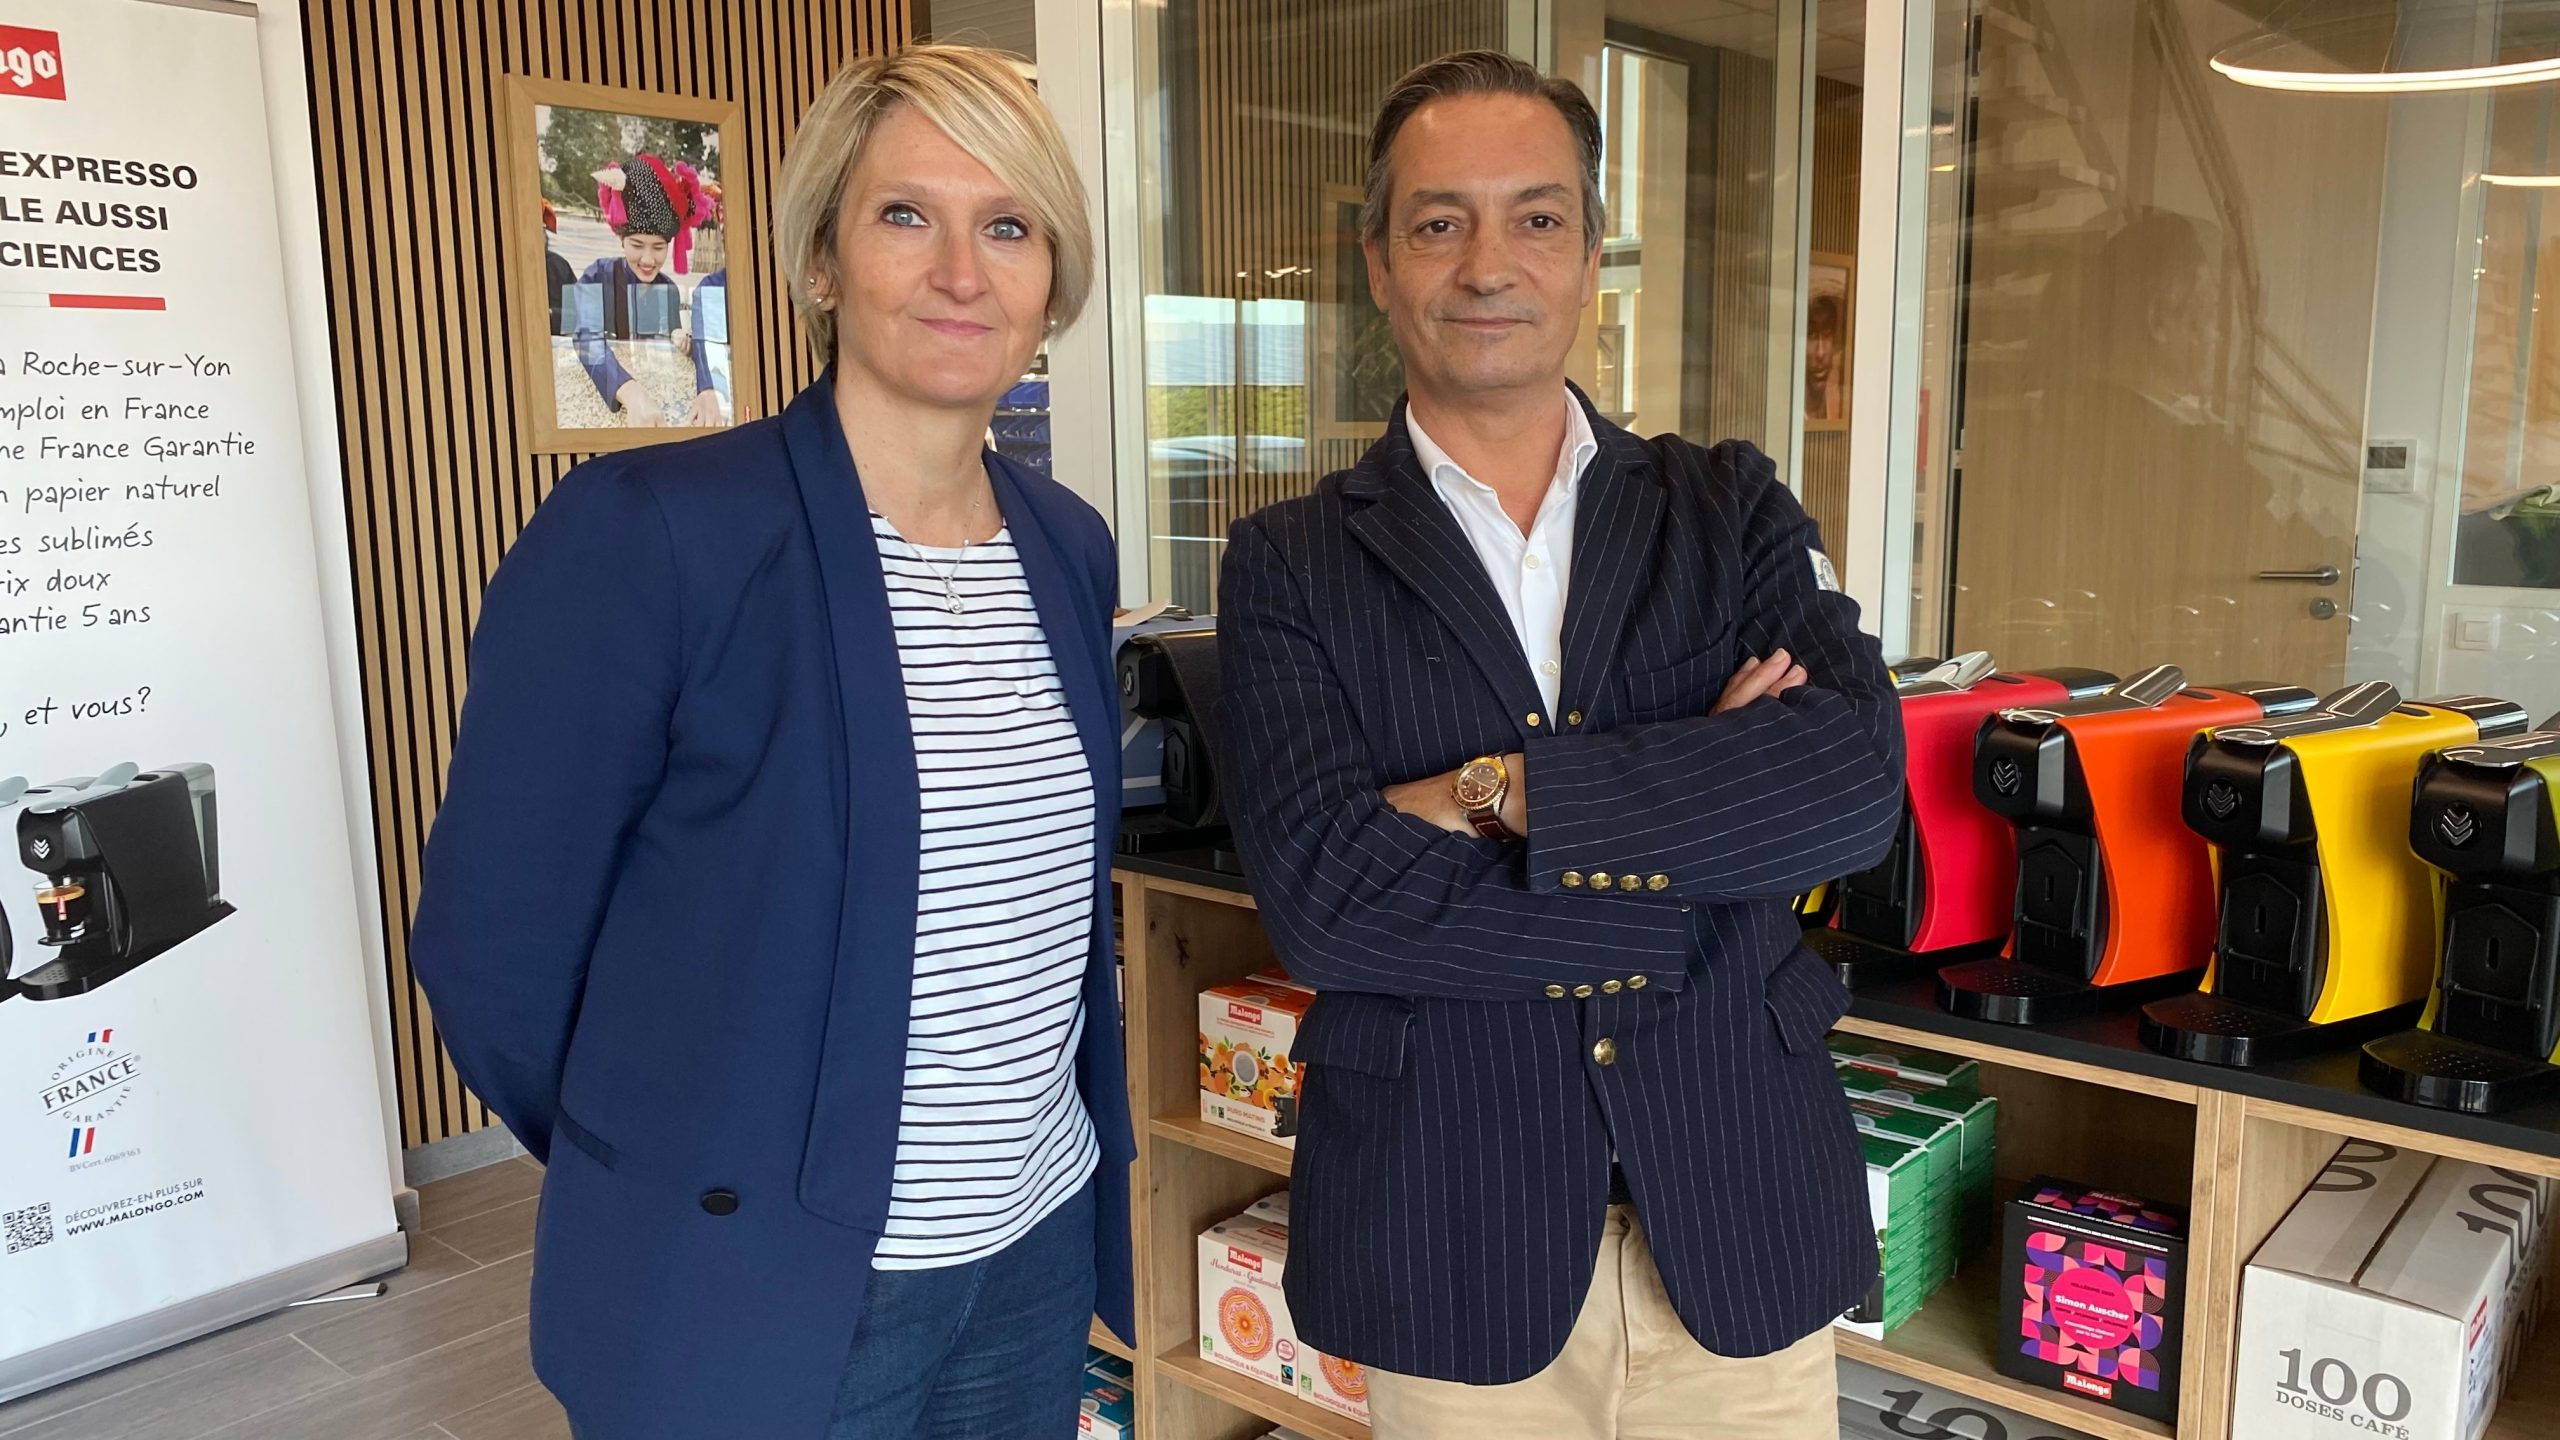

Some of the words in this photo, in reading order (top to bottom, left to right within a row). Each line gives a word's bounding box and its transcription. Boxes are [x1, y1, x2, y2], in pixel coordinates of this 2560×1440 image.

[0, 151, 198, 190] EXPRESSO
[55, 200, 169, 231] AUSSI
[0, 241, 161, 273] CIENCES
[23, 351, 231, 377] Roche-sur-Yon
[81, 404, 109, 420] en
[124, 397, 209, 420] France
[40, 436, 129, 459] France
[144, 432, 255, 462] Garantie
[26, 477, 110, 513] papier
[126, 475, 220, 500] naturel
[38, 521, 153, 552] sublimés
[47, 568, 111, 592] doux
[82, 603, 101, 627] 5
[109, 606, 151, 625] ans
[25, 696, 59, 725] et
[72, 686, 151, 719] vous?
[1229, 1004, 1261, 1023] Malongo
[51, 1047, 115, 1081] ORIGINE
[42, 1057, 137, 1109] FRANCE
[62, 1086, 132, 1123] GARANTIE
[65, 1191, 153, 1225] DÉCOUVREZ-EN
[156, 1183, 181, 1199] PLUS
[183, 1177, 204, 1191] SUR
[66, 1189, 204, 1236] WWW.MALONGO.COM
[1229, 1249, 1261, 1270] Malongo
[2055, 1294, 2087, 1310] Simon
[2088, 1303, 2129, 1321] Auscher
[2066, 1374, 2109, 1396] Malongo
[2277, 1348, 2412, 1422] 100
[2275, 1390, 2344, 1422] DOSES
[2350, 1413, 2410, 1440] CAFÉ
